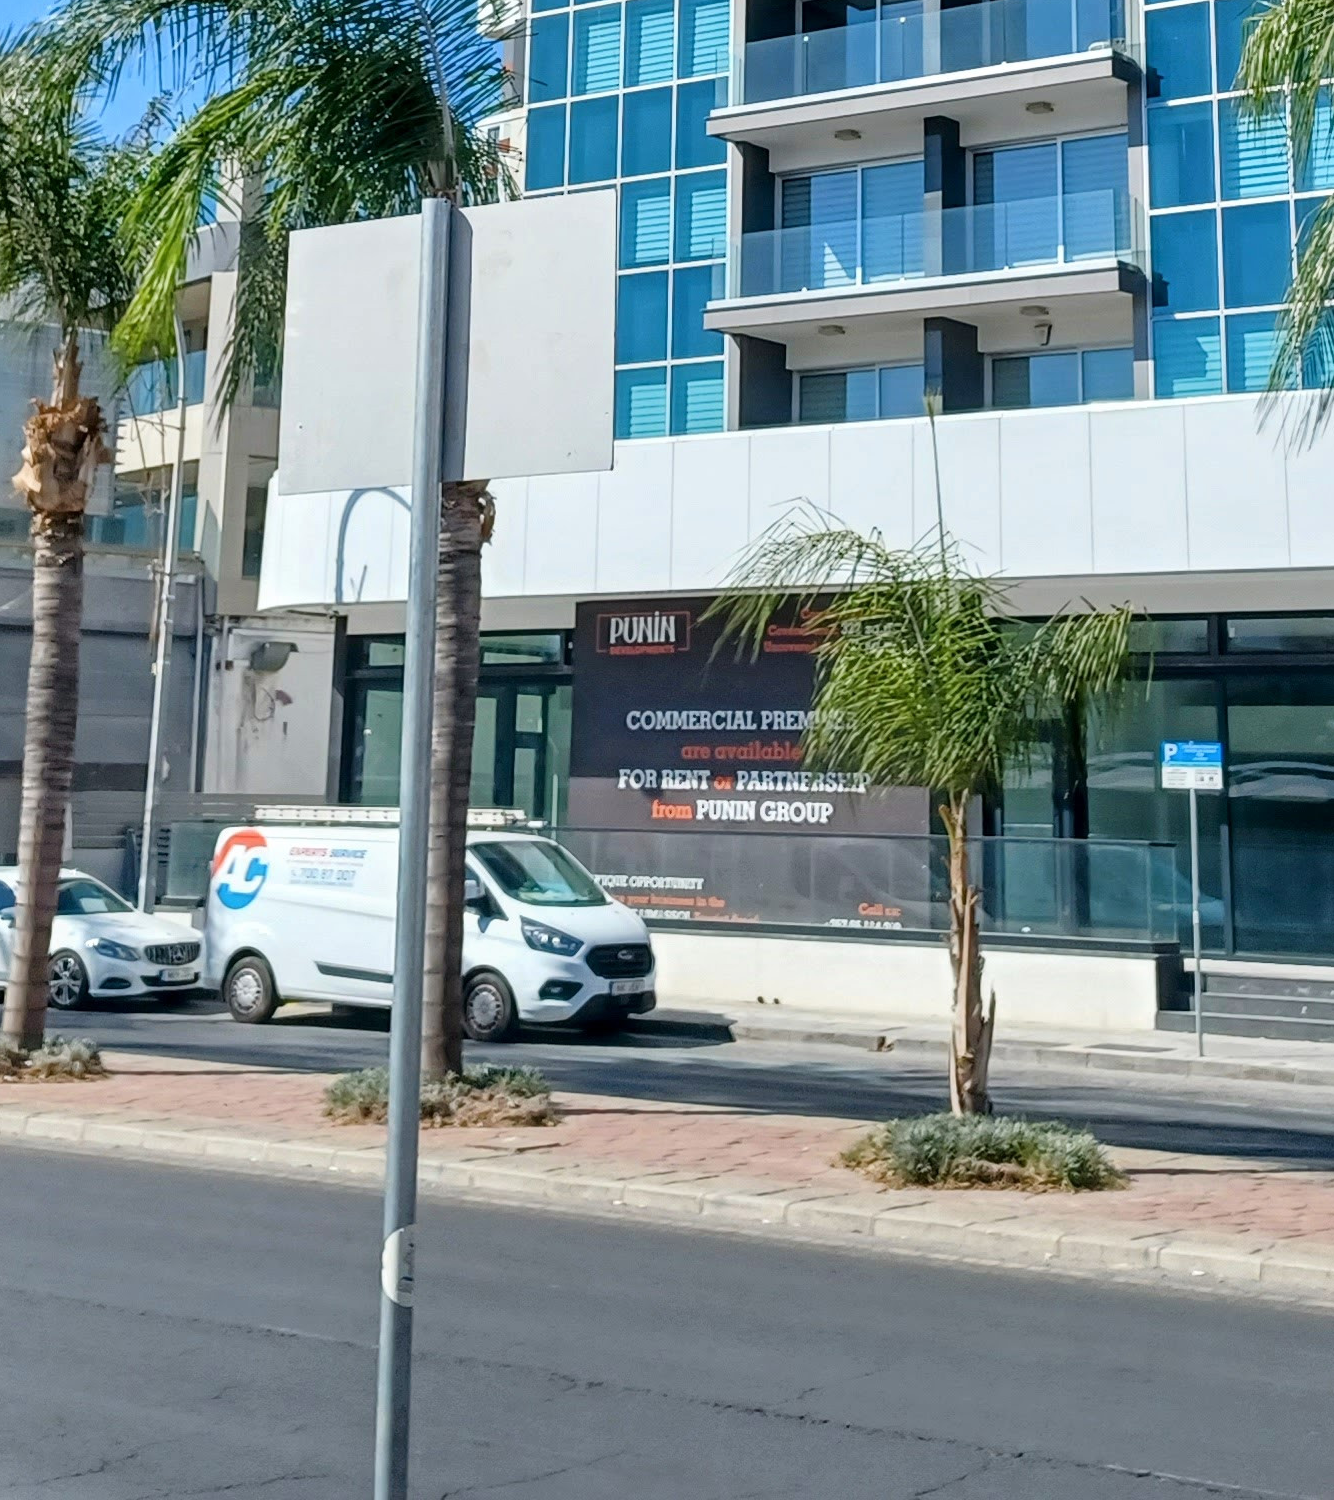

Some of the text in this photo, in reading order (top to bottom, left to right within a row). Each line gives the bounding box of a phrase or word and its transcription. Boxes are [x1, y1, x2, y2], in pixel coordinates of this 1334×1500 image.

[626, 710, 757, 731] COMMERCIAL
[681, 740, 802, 760] are available
[617, 768, 658, 790] FOR
[661, 769, 711, 790] RENT
[713, 776, 734, 790] or
[651, 799, 834, 824] from PUNIN GROUP
